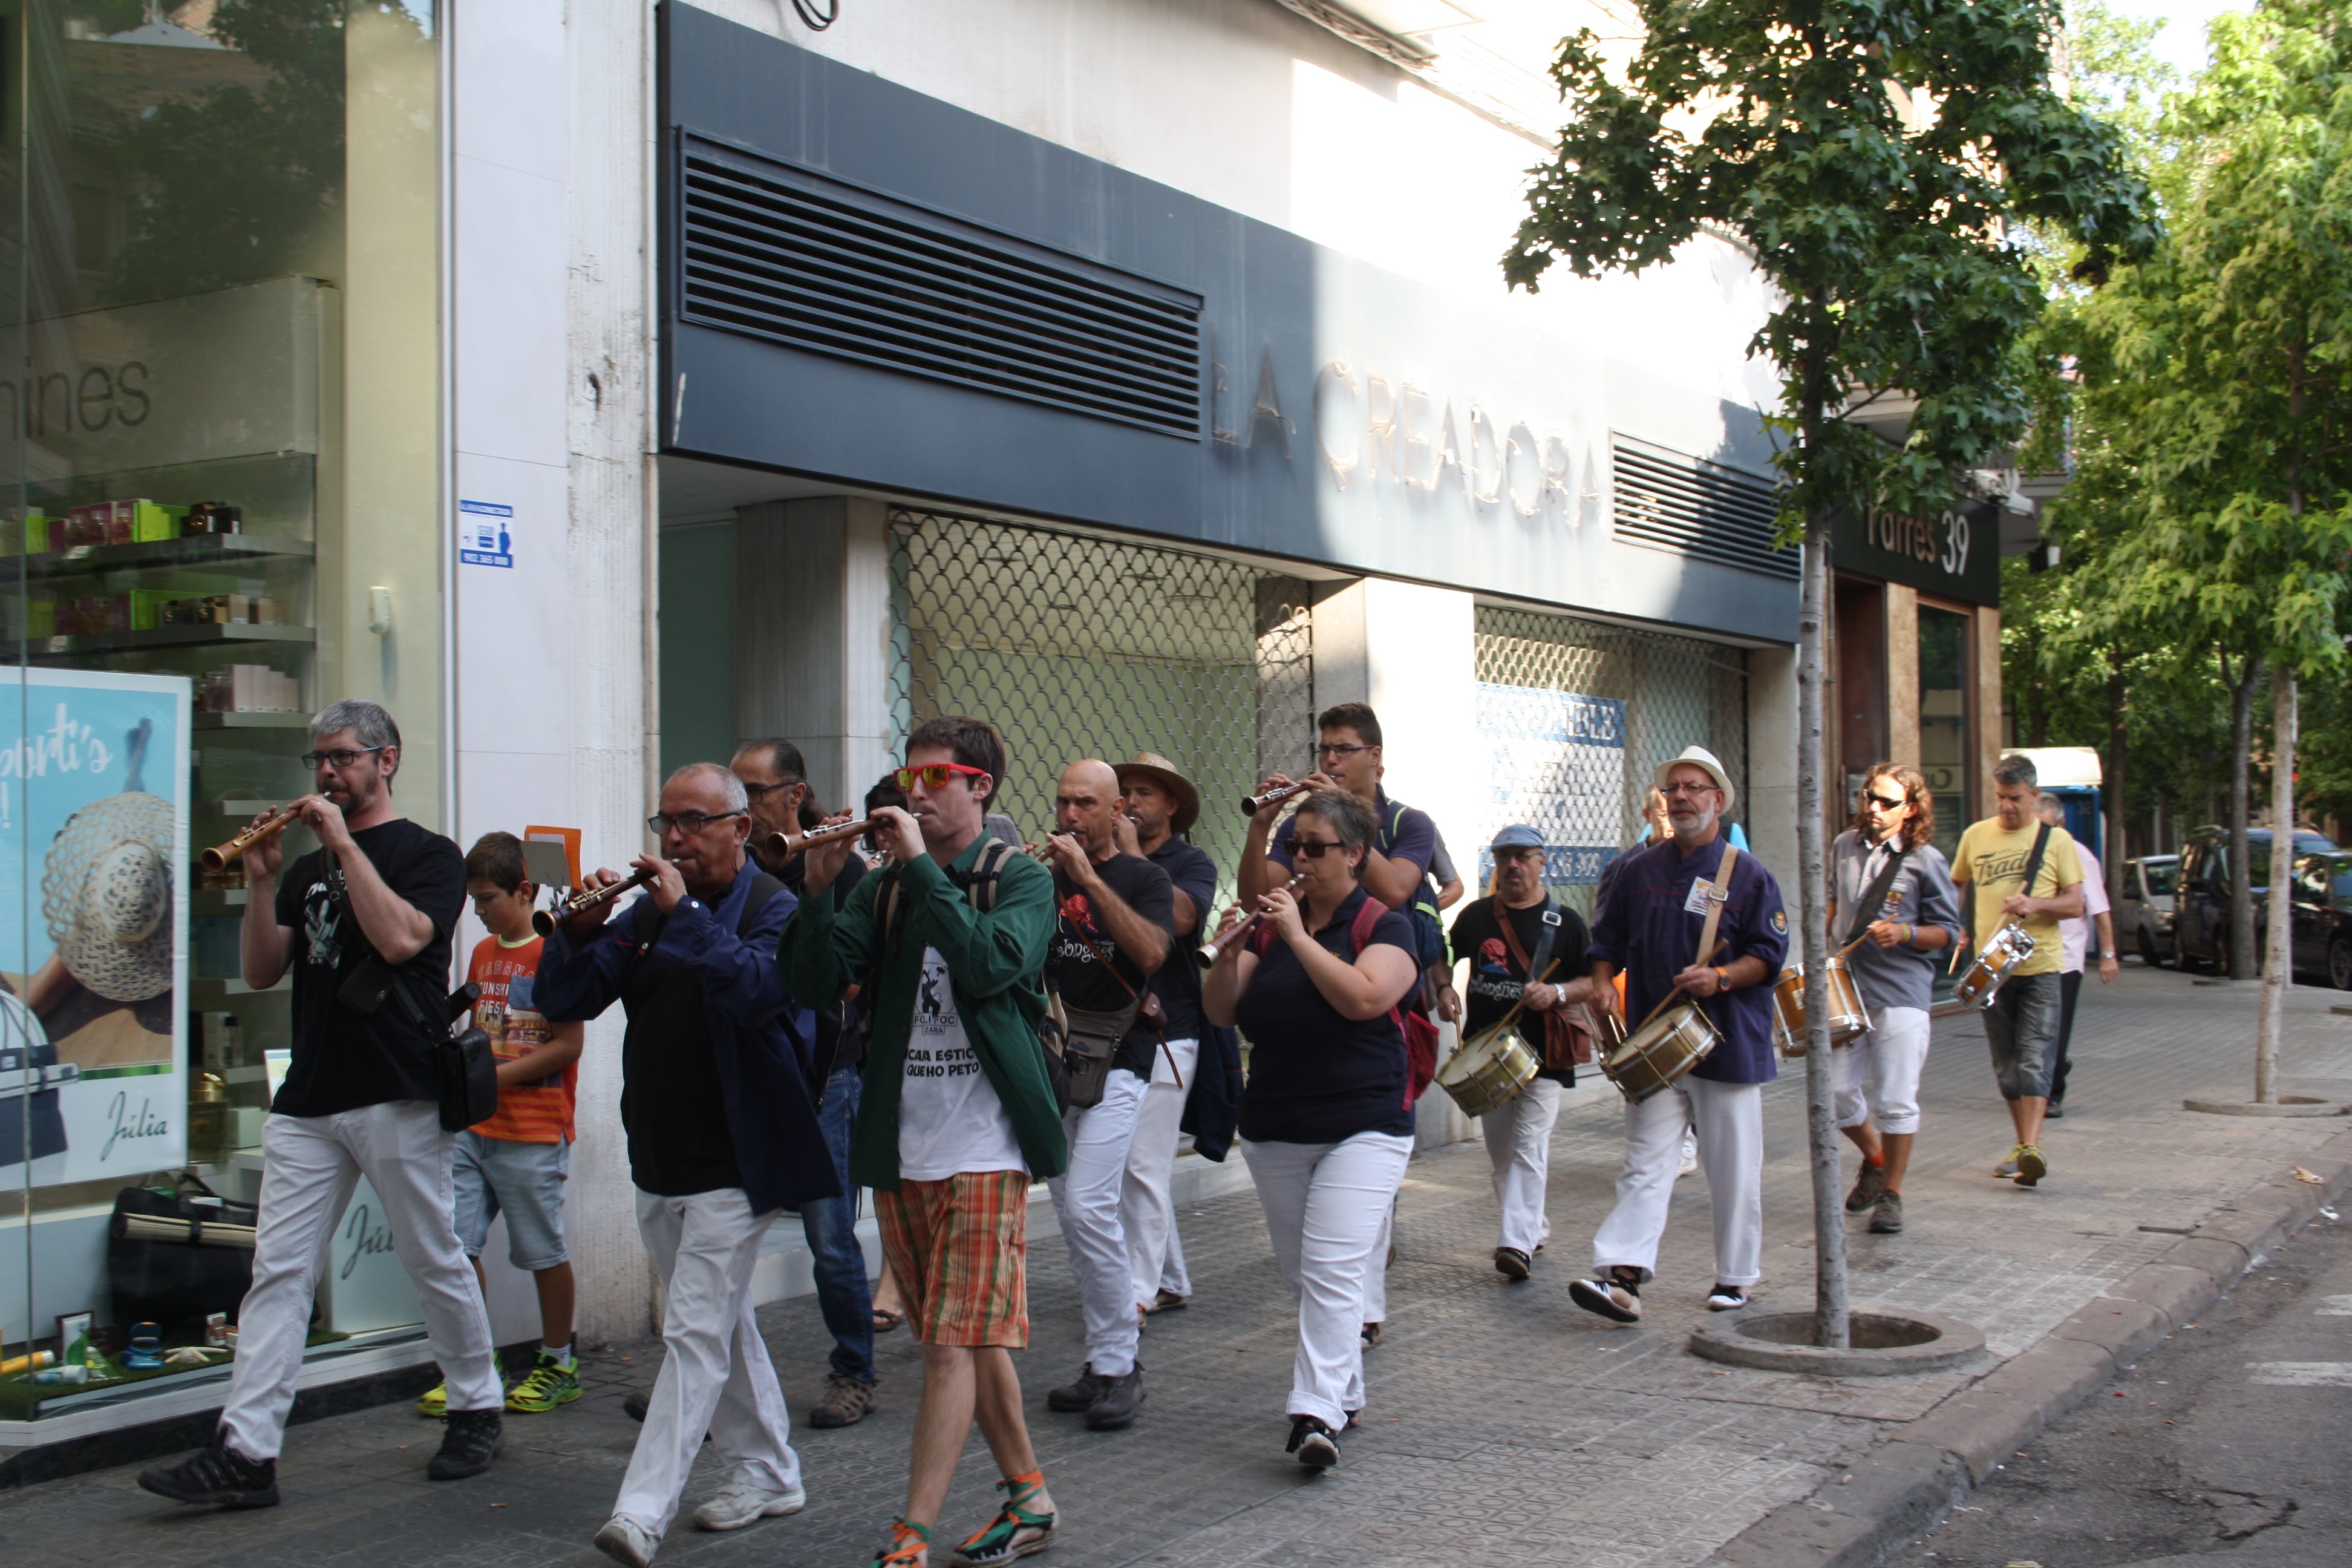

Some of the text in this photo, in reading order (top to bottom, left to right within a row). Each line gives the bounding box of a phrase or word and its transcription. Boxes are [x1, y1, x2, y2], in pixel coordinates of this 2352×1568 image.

[1211, 322, 1602, 528] LA CREADORA
[1941, 509, 1970, 576] 39
[936, 1047, 975, 1062] ESTIC
[948, 1062, 979, 1077] PETO
[99, 1091, 170, 1162] Júlia
